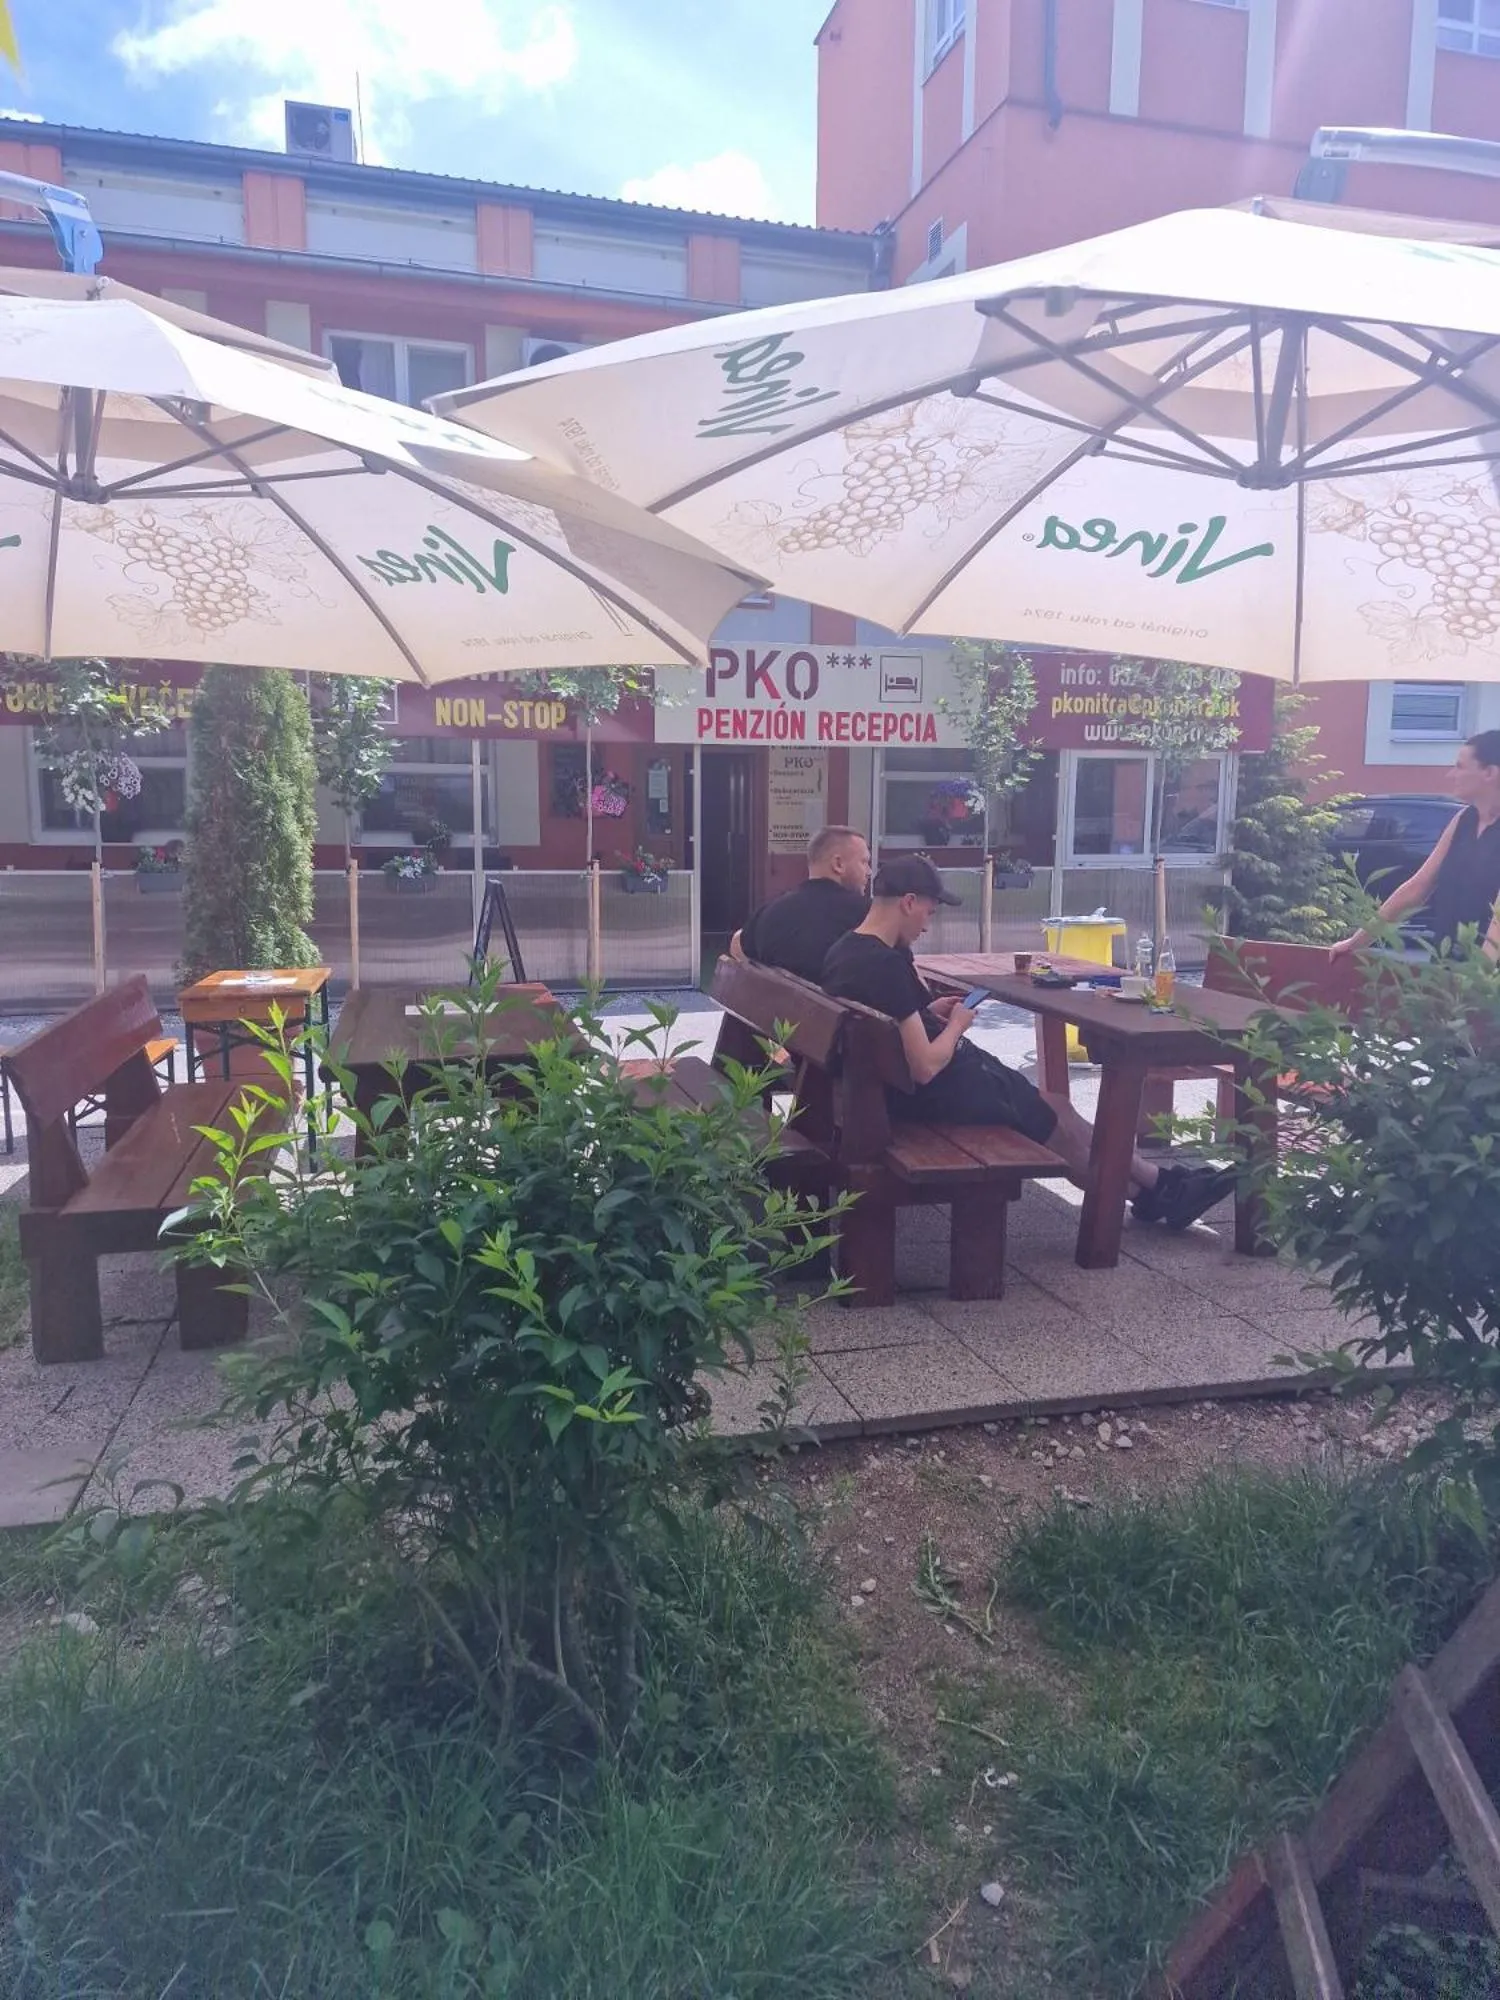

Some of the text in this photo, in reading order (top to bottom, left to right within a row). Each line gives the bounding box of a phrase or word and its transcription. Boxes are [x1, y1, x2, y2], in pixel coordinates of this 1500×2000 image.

[1060, 662, 1102, 686] info:
[435, 697, 567, 730] NON-STOP
[697, 701, 938, 743] PENZIÓN RECEPCIA
